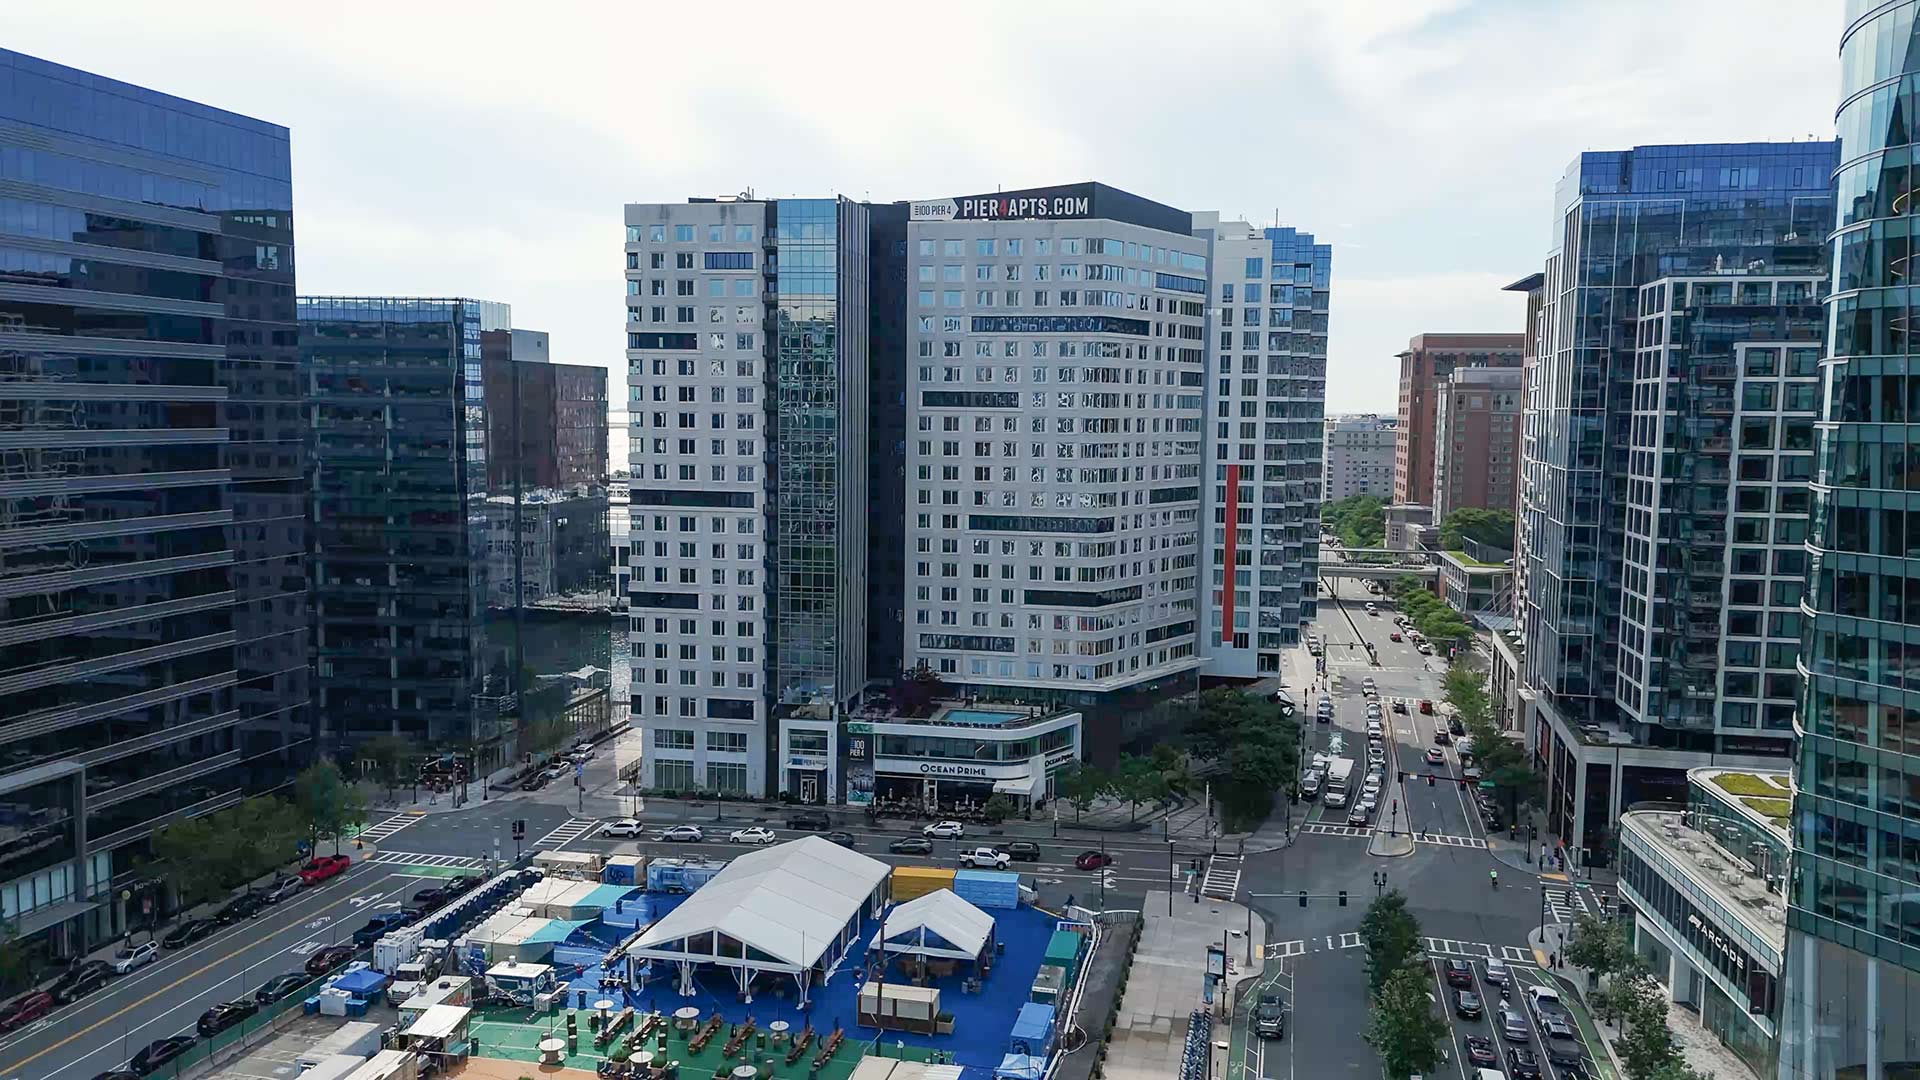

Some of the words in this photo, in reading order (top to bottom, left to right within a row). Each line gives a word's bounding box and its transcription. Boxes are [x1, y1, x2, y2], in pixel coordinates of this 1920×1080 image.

[931, 205, 946, 216] PIER
[963, 197, 1089, 217] PIER4APTS.COM
[920, 763, 956, 774] OCEAN
[957, 766, 986, 776] PRIME
[1700, 924, 1744, 970] ARCADE
